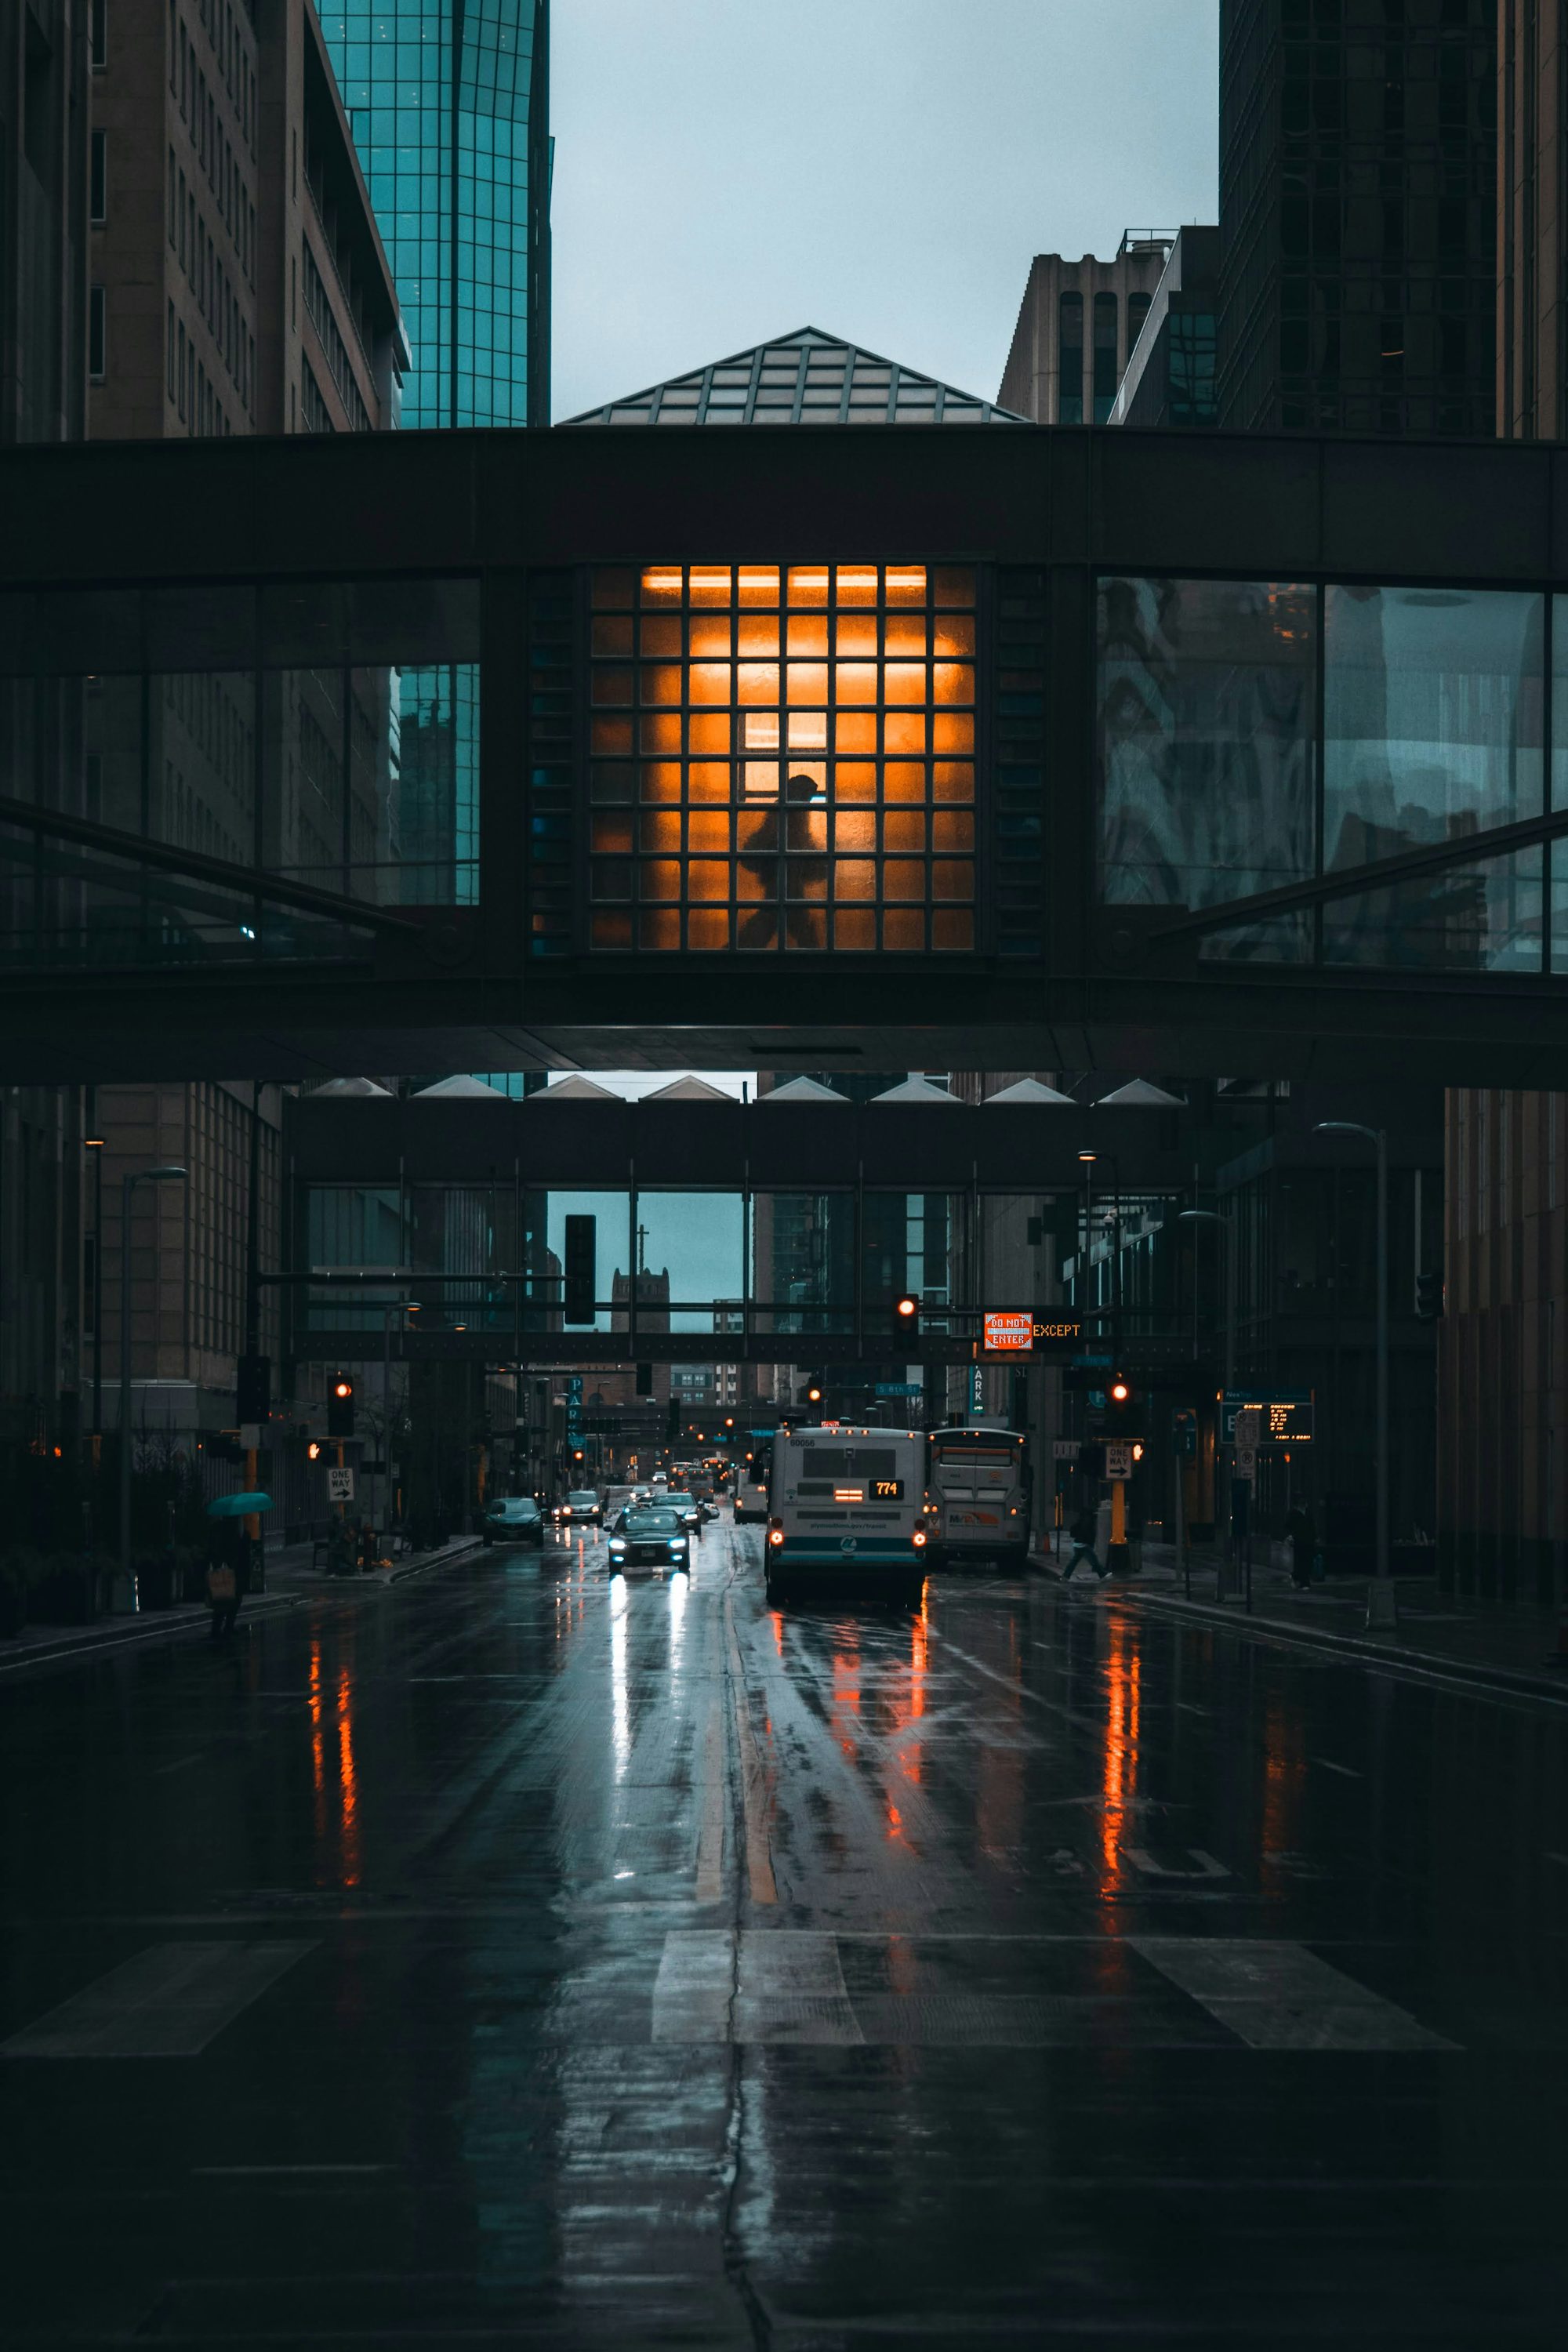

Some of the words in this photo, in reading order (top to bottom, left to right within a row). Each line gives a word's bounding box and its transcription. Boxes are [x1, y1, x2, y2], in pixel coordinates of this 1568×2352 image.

[992, 1319, 1002, 1327] DO
[1006, 1319, 1025, 1327] NOT
[1033, 1324, 1081, 1337] EXCEPT
[993, 1335, 1025, 1344] ENTER
[974, 1365, 982, 1400] ARK
[908, 1385, 916, 1394] St
[332, 1470, 350, 1479] ONE
[332, 1479, 350, 1487] WAY
[876, 1482, 898, 1495] 774
